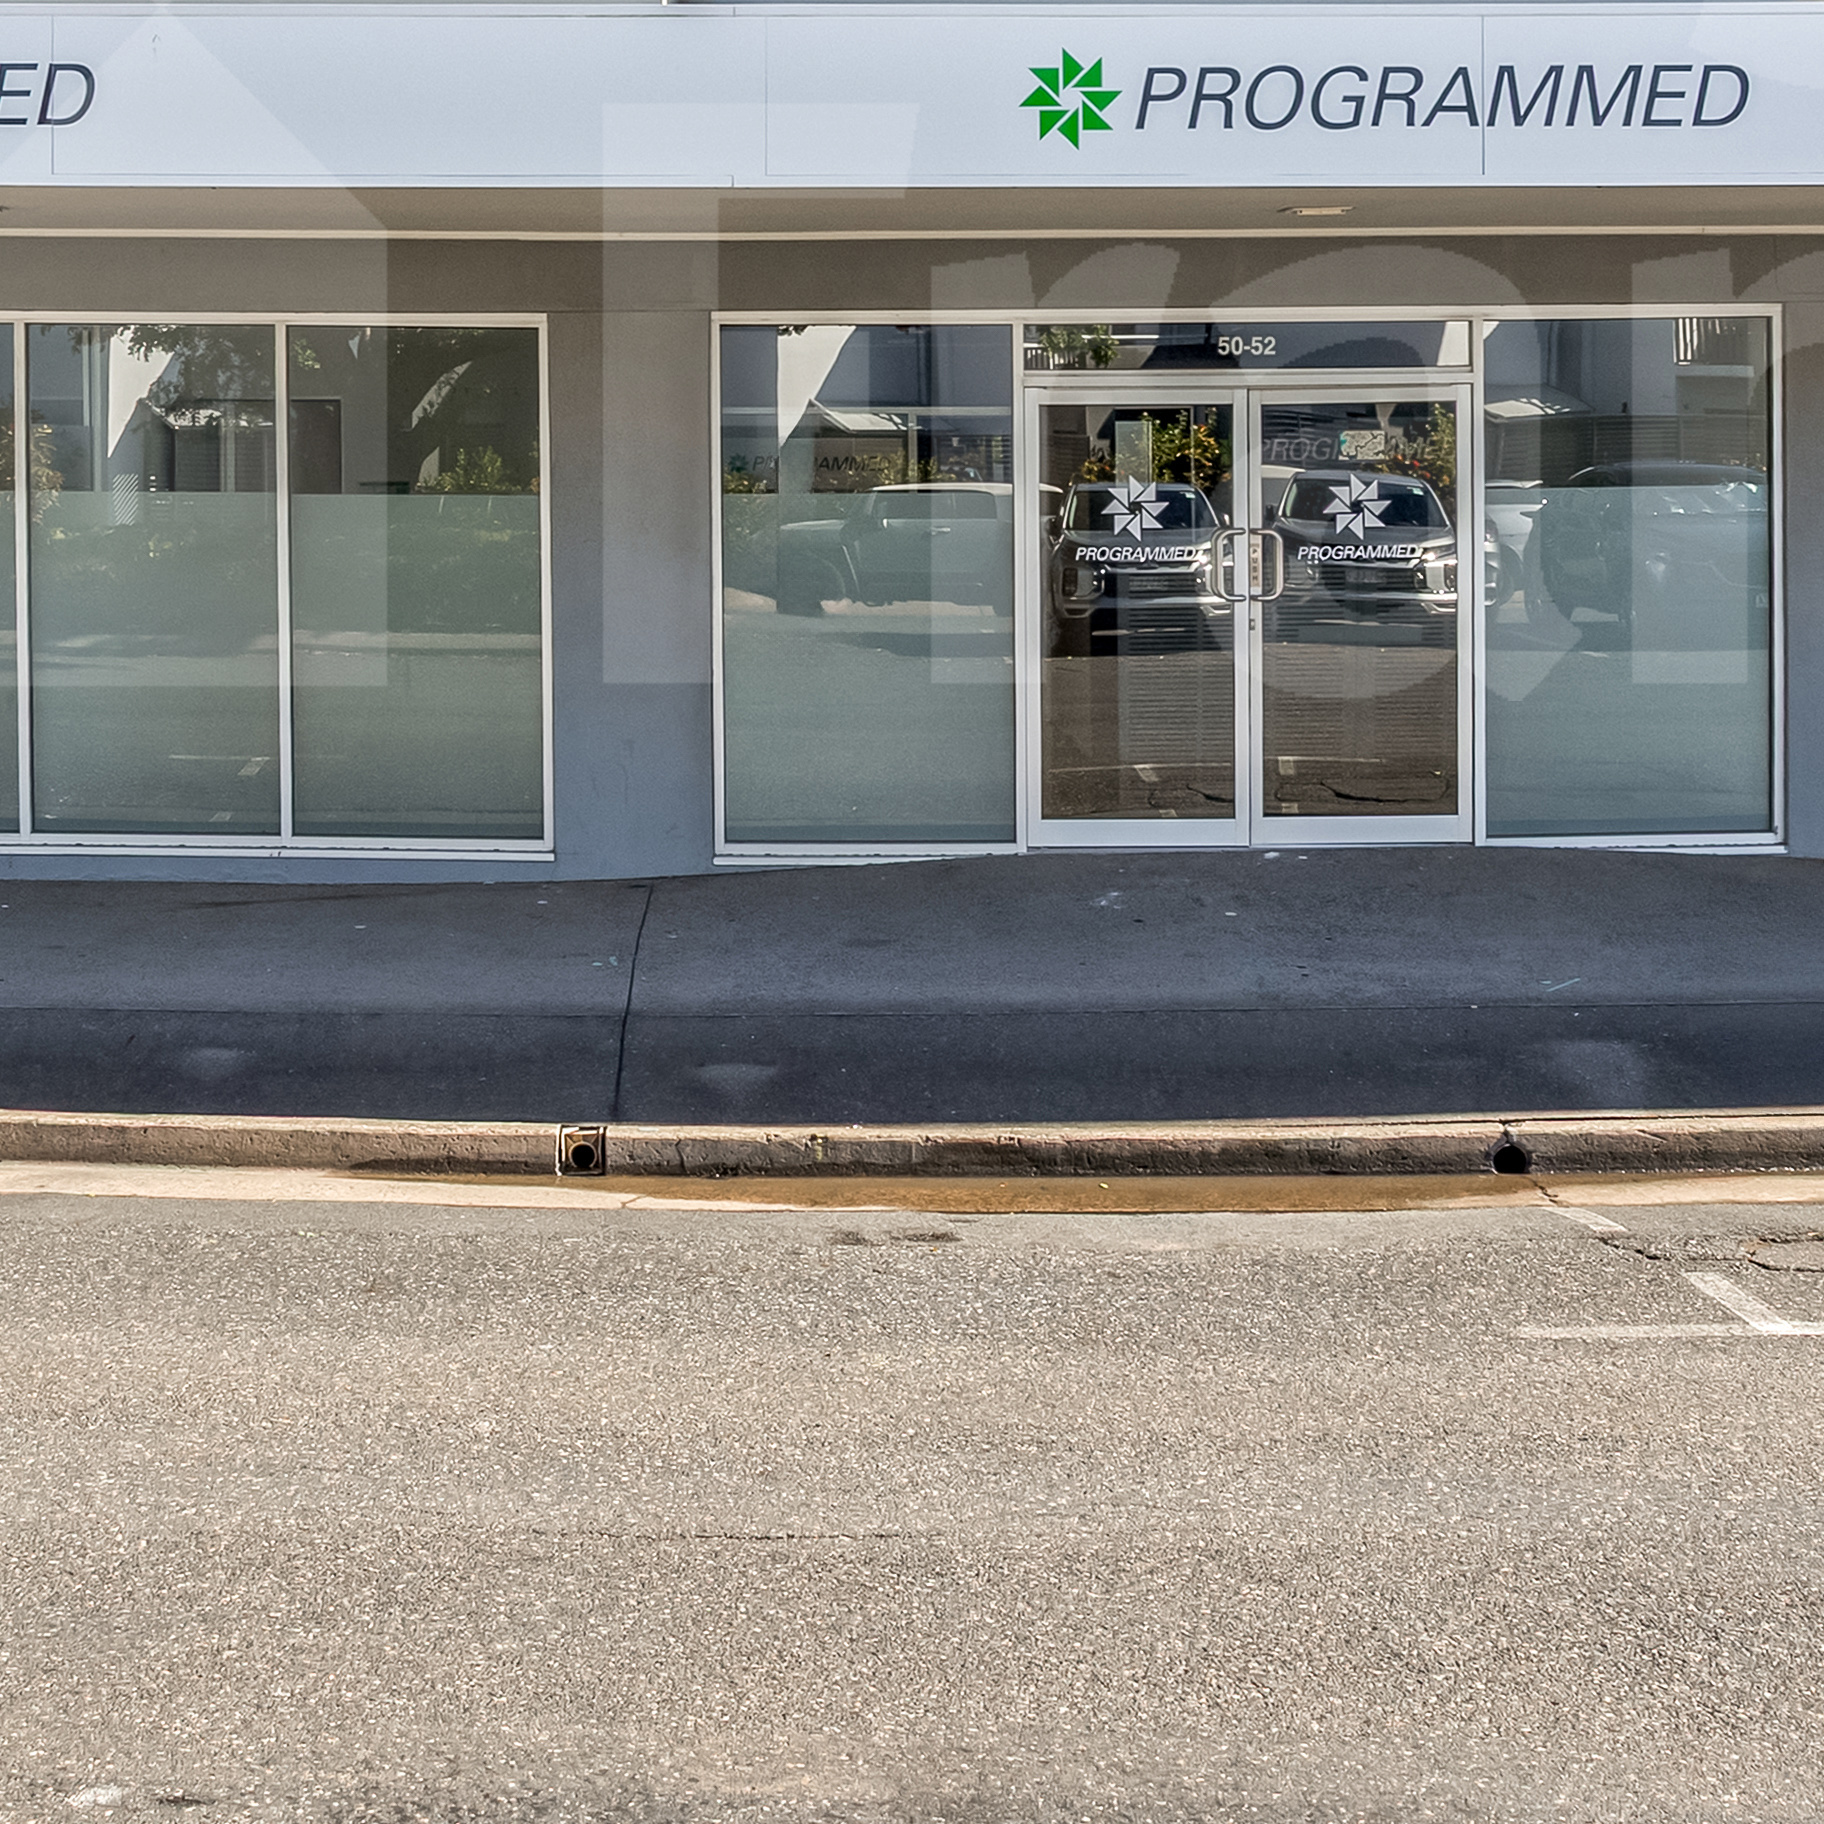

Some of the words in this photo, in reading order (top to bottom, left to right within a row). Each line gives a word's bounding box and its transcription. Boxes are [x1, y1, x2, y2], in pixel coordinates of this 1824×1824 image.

[1134, 64, 1751, 131] PROGRAMMED
[1218, 336, 1276, 355] 50-52
[1076, 547, 1197, 561] PROGRAMMED
[1298, 545, 1419, 560] PROGRAMMED
